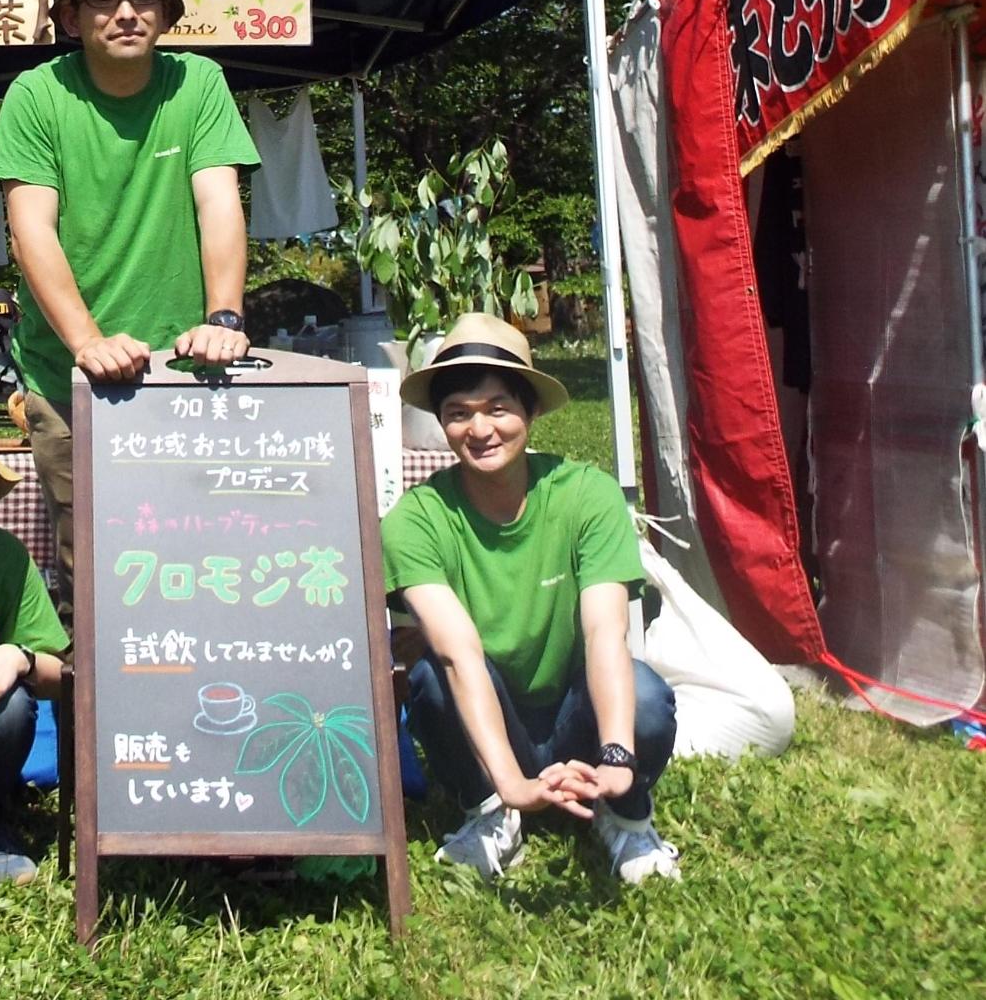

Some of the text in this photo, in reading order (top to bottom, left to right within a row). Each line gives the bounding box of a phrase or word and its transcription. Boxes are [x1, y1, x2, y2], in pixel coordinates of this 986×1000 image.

[234, 8, 298, 40] ¥300
[170, 394, 264, 421] 加美町
[109, 430, 335, 459] 地域おこし協力隊
[206, 465, 310, 493] プロデュース
[114, 545, 349, 607] クロモジ茶
[114, 731, 191, 764] 販売も
[128, 776, 234, 809] しています
